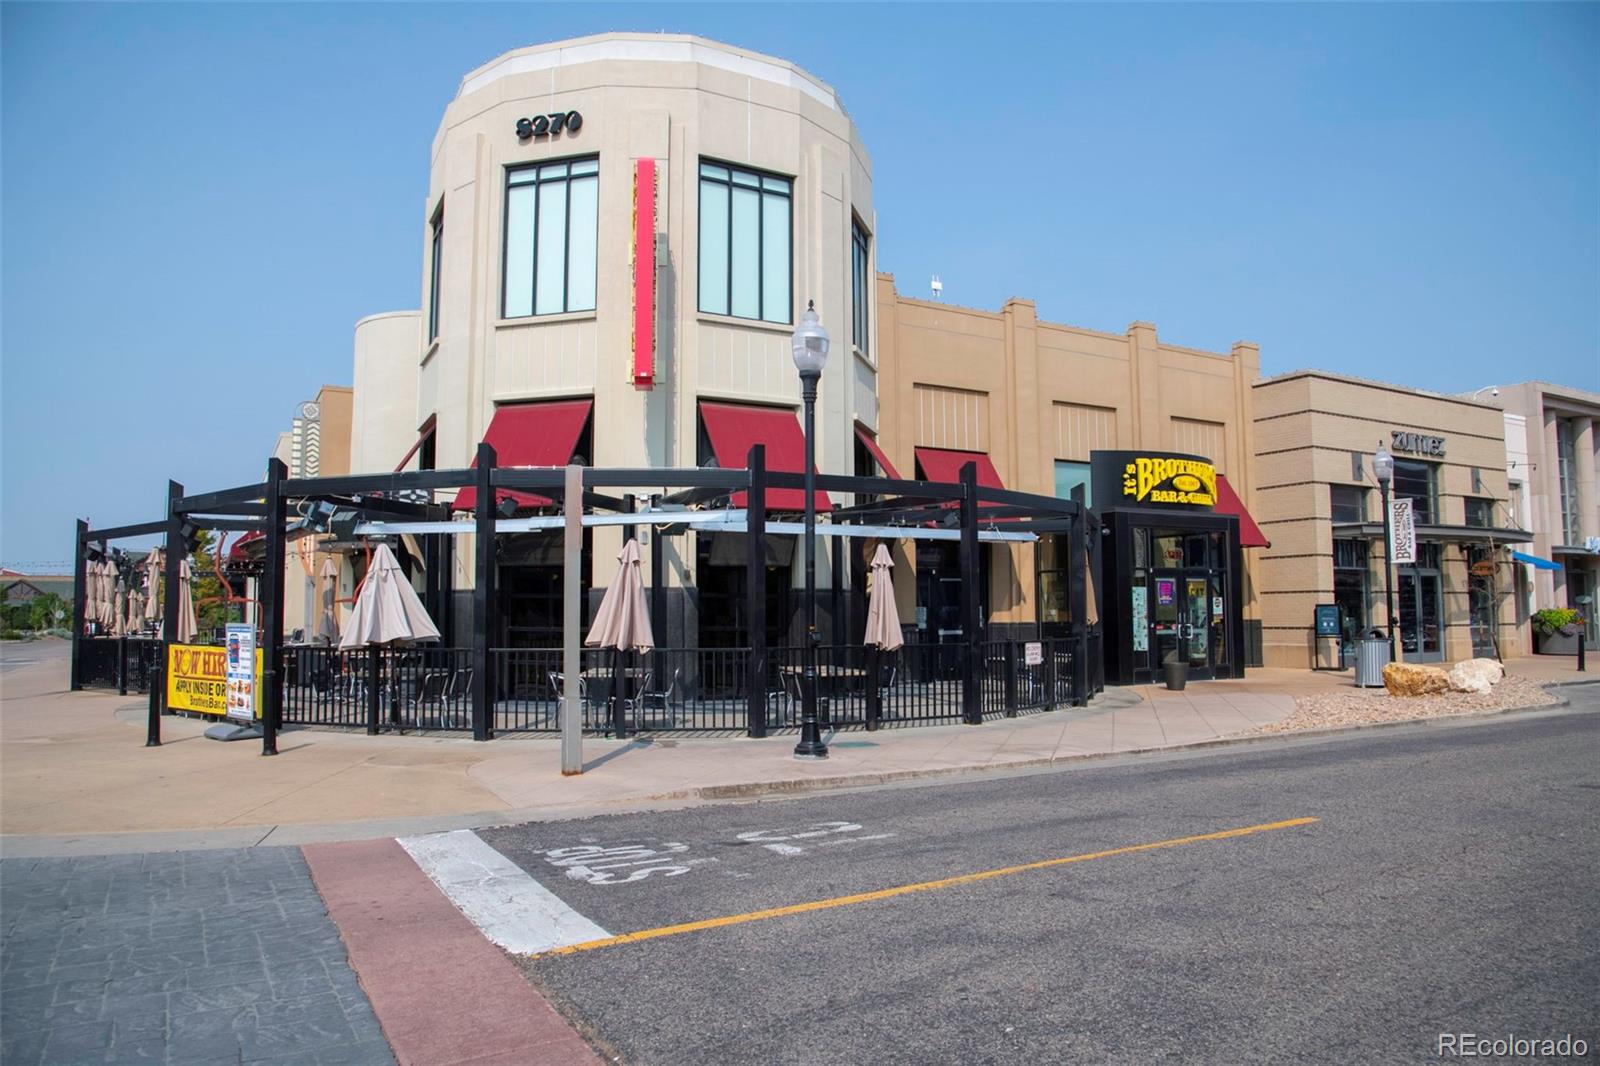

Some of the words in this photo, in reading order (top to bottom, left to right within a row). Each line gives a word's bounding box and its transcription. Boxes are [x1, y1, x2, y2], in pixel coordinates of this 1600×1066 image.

[516, 110, 583, 139] 8270
[1150, 490, 1177, 503] BAR
[1394, 502, 1411, 560] BROTHERS
[174, 649, 201, 676] NOW
[203, 651, 227, 677] HIR
